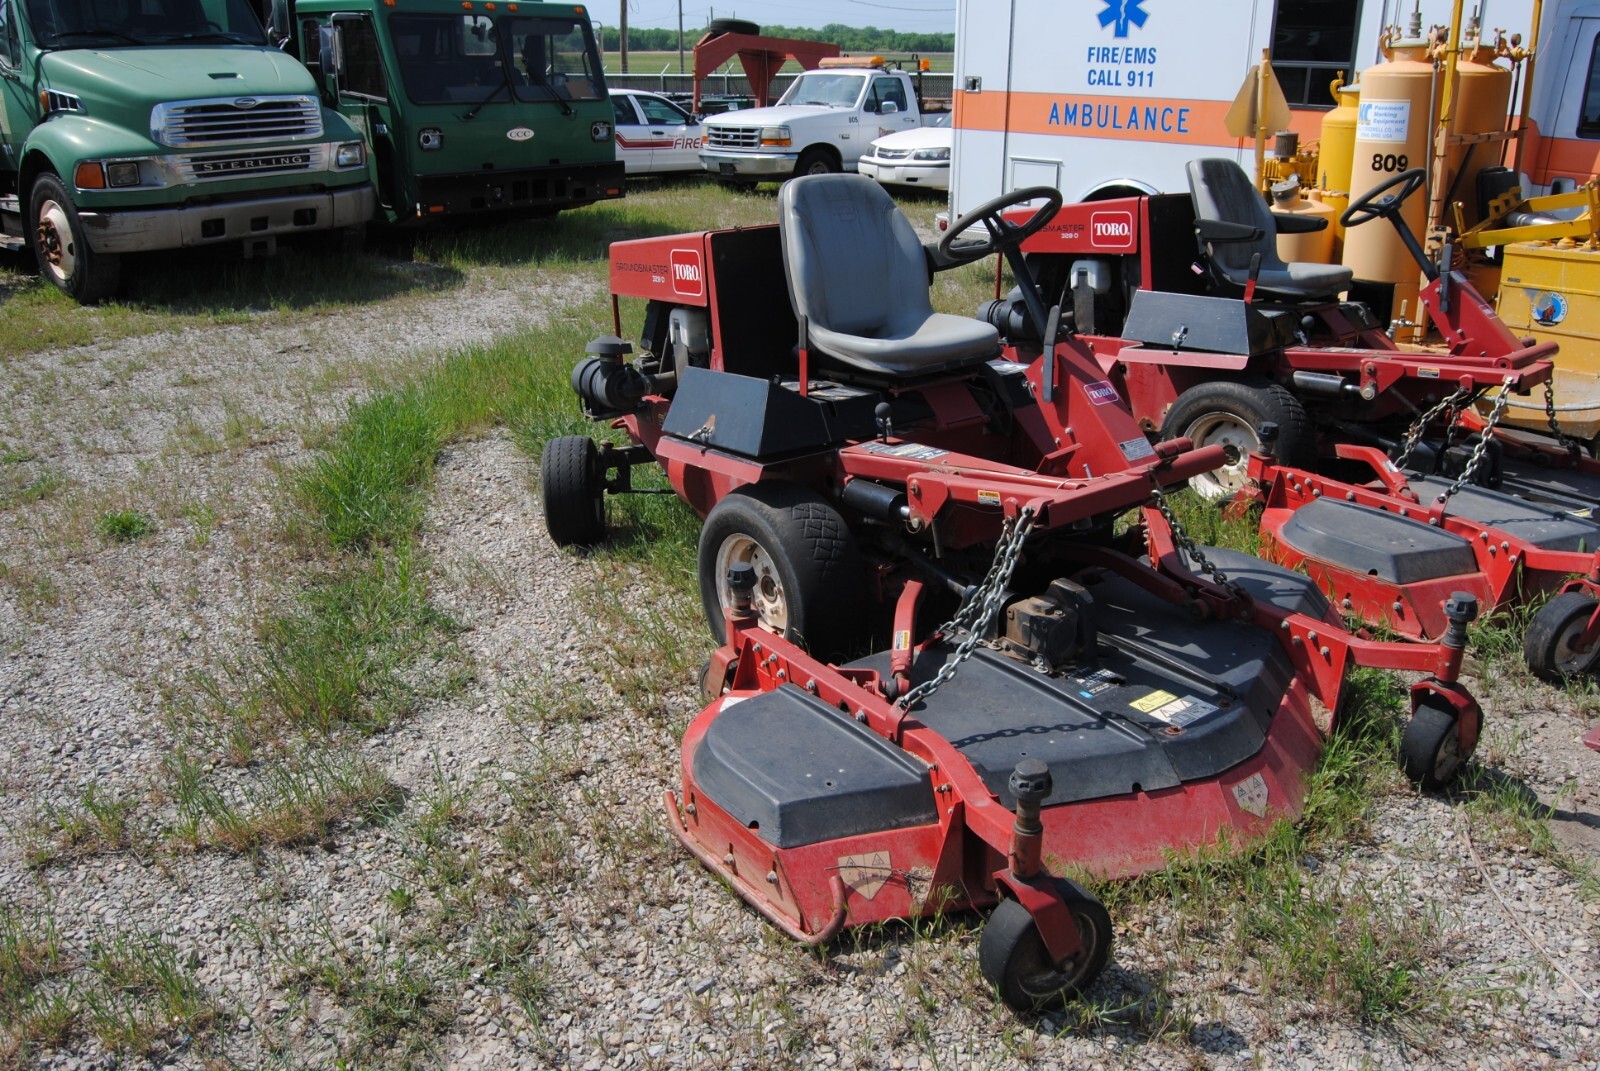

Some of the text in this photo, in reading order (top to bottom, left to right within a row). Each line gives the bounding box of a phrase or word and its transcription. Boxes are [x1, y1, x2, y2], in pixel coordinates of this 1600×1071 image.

[1087, 46, 1157, 65] FIRE/EMS
[1087, 69, 1154, 87] CALL 911
[1048, 102, 1190, 133] AMBULANCE
[1373, 111, 1398, 119] Marking
[509, 130, 531, 138] CCC
[203, 156, 302, 171] STERLING
[1371, 153, 1409, 173] 809
[1094, 222, 1130, 236] TORO
[616, 262, 668, 274] GROUNDSMASTER
[674, 263, 700, 281] TORO
[1089, 386, 1114, 399] TORO
